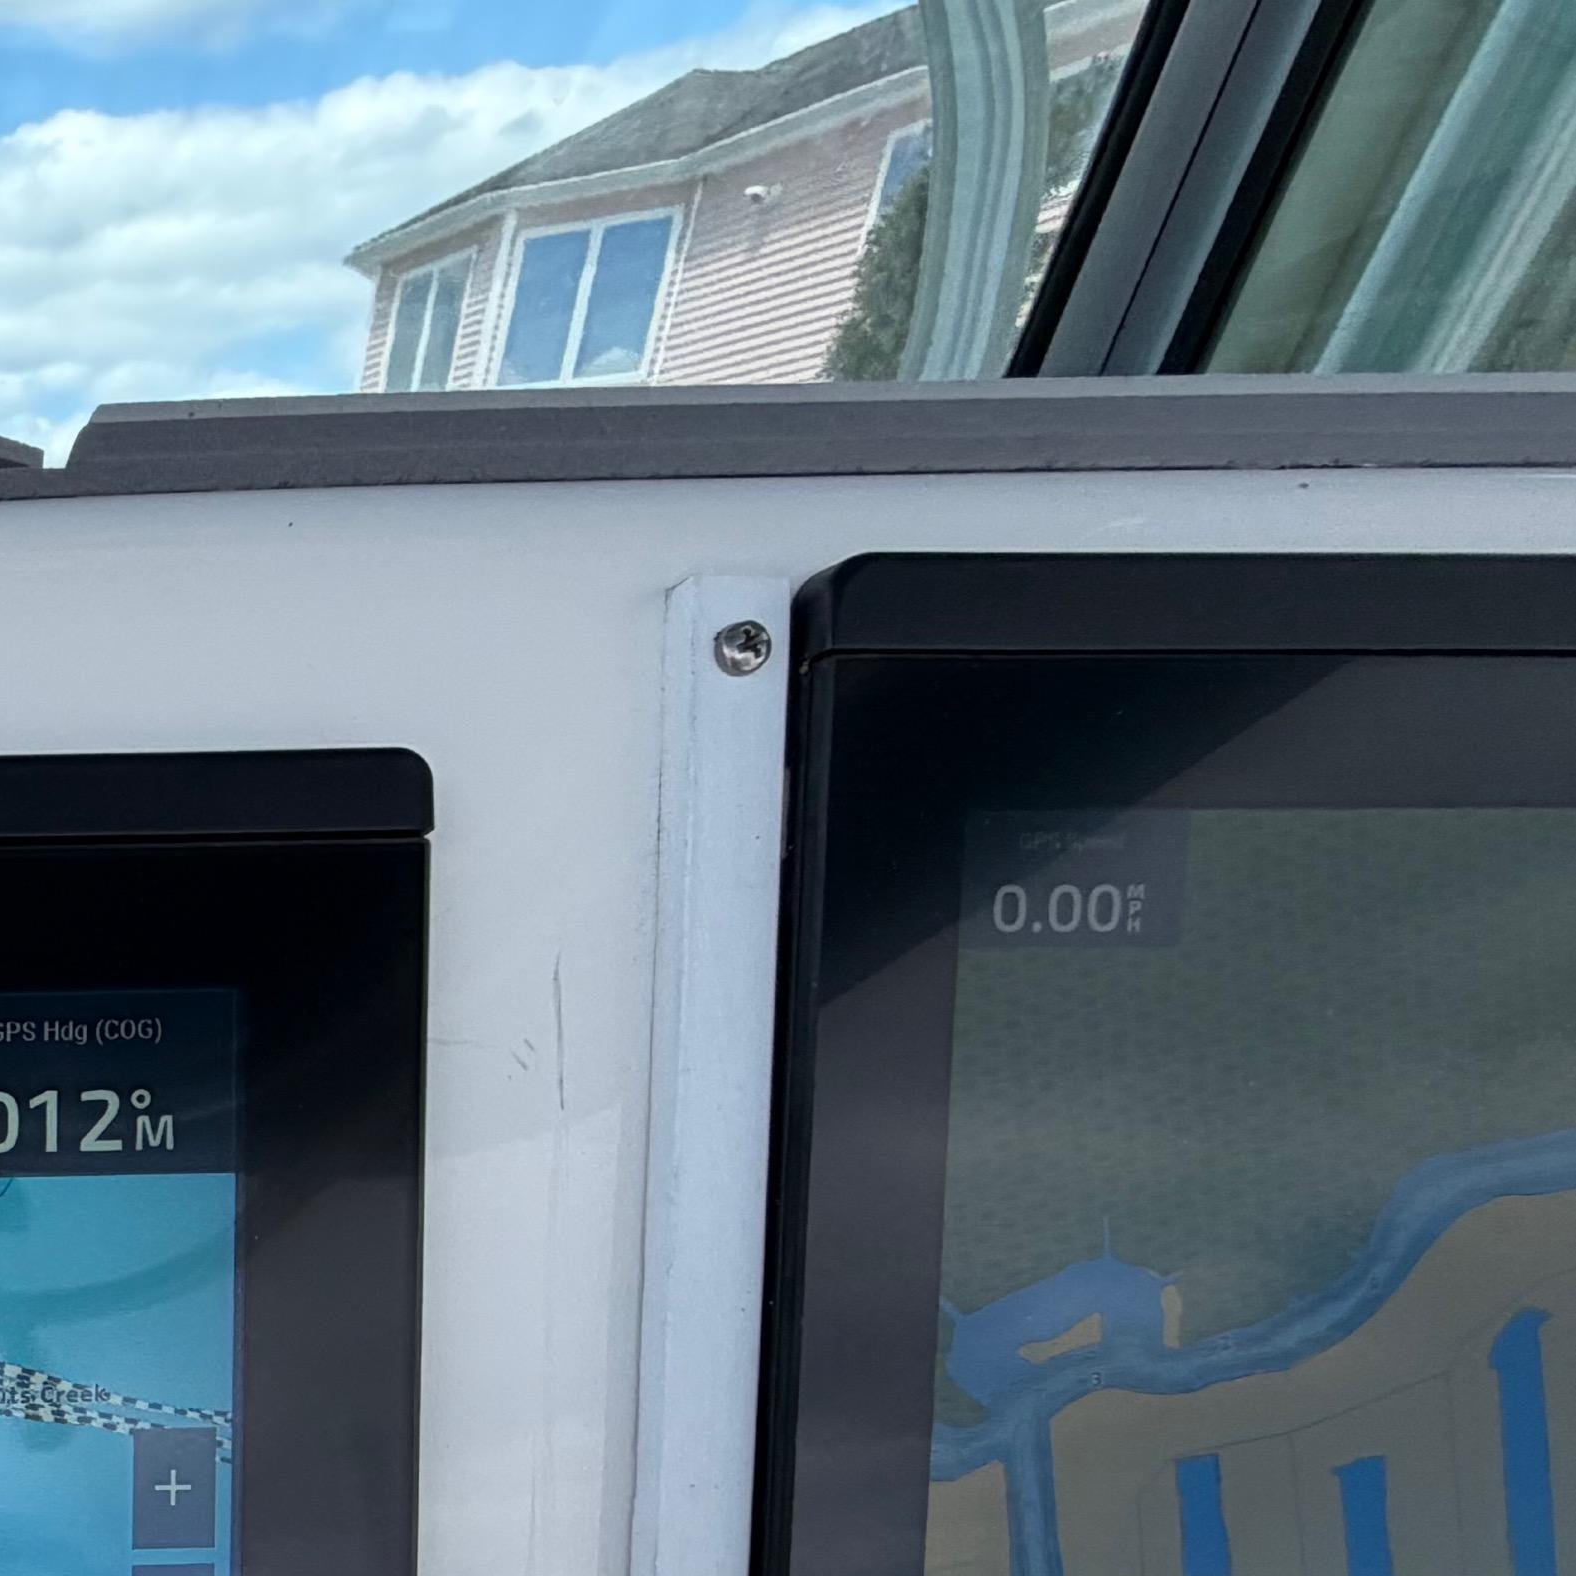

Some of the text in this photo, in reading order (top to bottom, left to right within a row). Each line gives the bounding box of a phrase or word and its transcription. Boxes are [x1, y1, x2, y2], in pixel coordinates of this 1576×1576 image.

[993, 884, 1122, 933] 0.00
[43, 1020, 89, 1046] Hdg
[95, 1017, 163, 1047] (COG)
[40, 1382, 109, 1404] Creek
